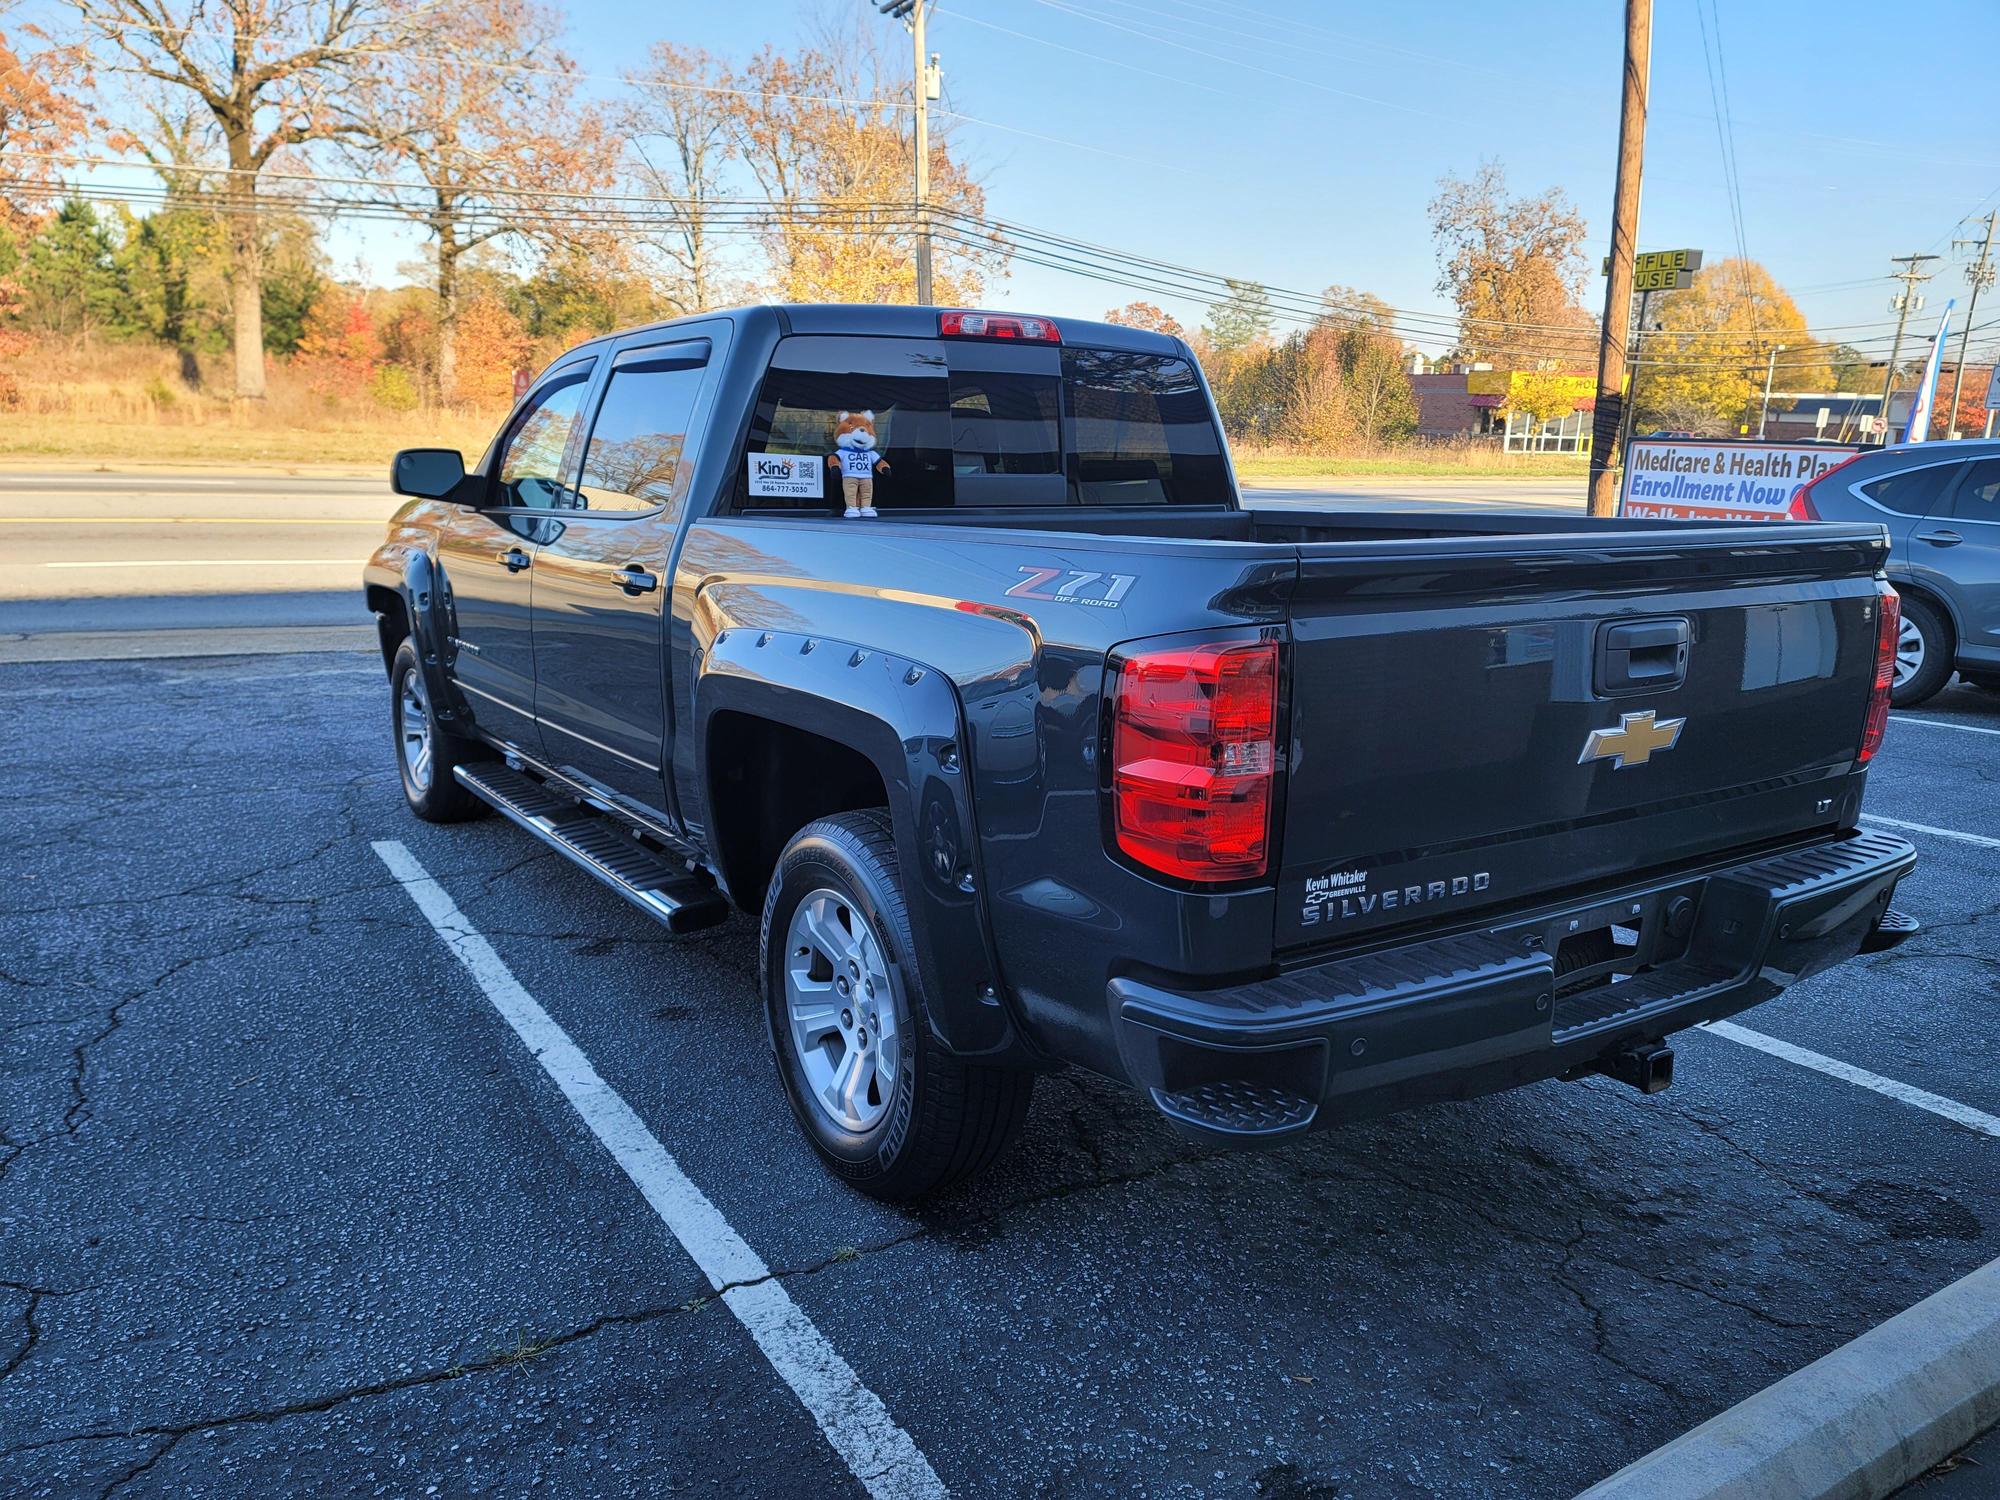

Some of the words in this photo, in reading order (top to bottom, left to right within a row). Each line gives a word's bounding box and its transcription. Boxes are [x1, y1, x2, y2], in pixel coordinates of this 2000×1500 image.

[1636, 271, 1674, 287] USE
[848, 453, 869, 462] CAR
[1634, 449, 1711, 473] Medicare
[1711, 452, 1725, 474] &
[1728, 453, 1792, 478] Health
[758, 461, 790, 479] King
[849, 462, 870, 471] FOX
[762, 485, 808, 493] 864-777-3030
[1630, 474, 1735, 501] Enrollment
[1736, 480, 1786, 506] Now
[1004, 565, 1138, 602] Z71
[1054, 595, 1080, 604] OFF
[1081, 598, 1119, 608] ROAD
[1815, 799, 1833, 814] LT
[1305, 876, 1329, 892] Kevin
[1330, 869, 1368, 888] Whitaker
[1300, 872, 1490, 927] SILVERADO
[1329, 885, 1367, 898] GREENVILLE
